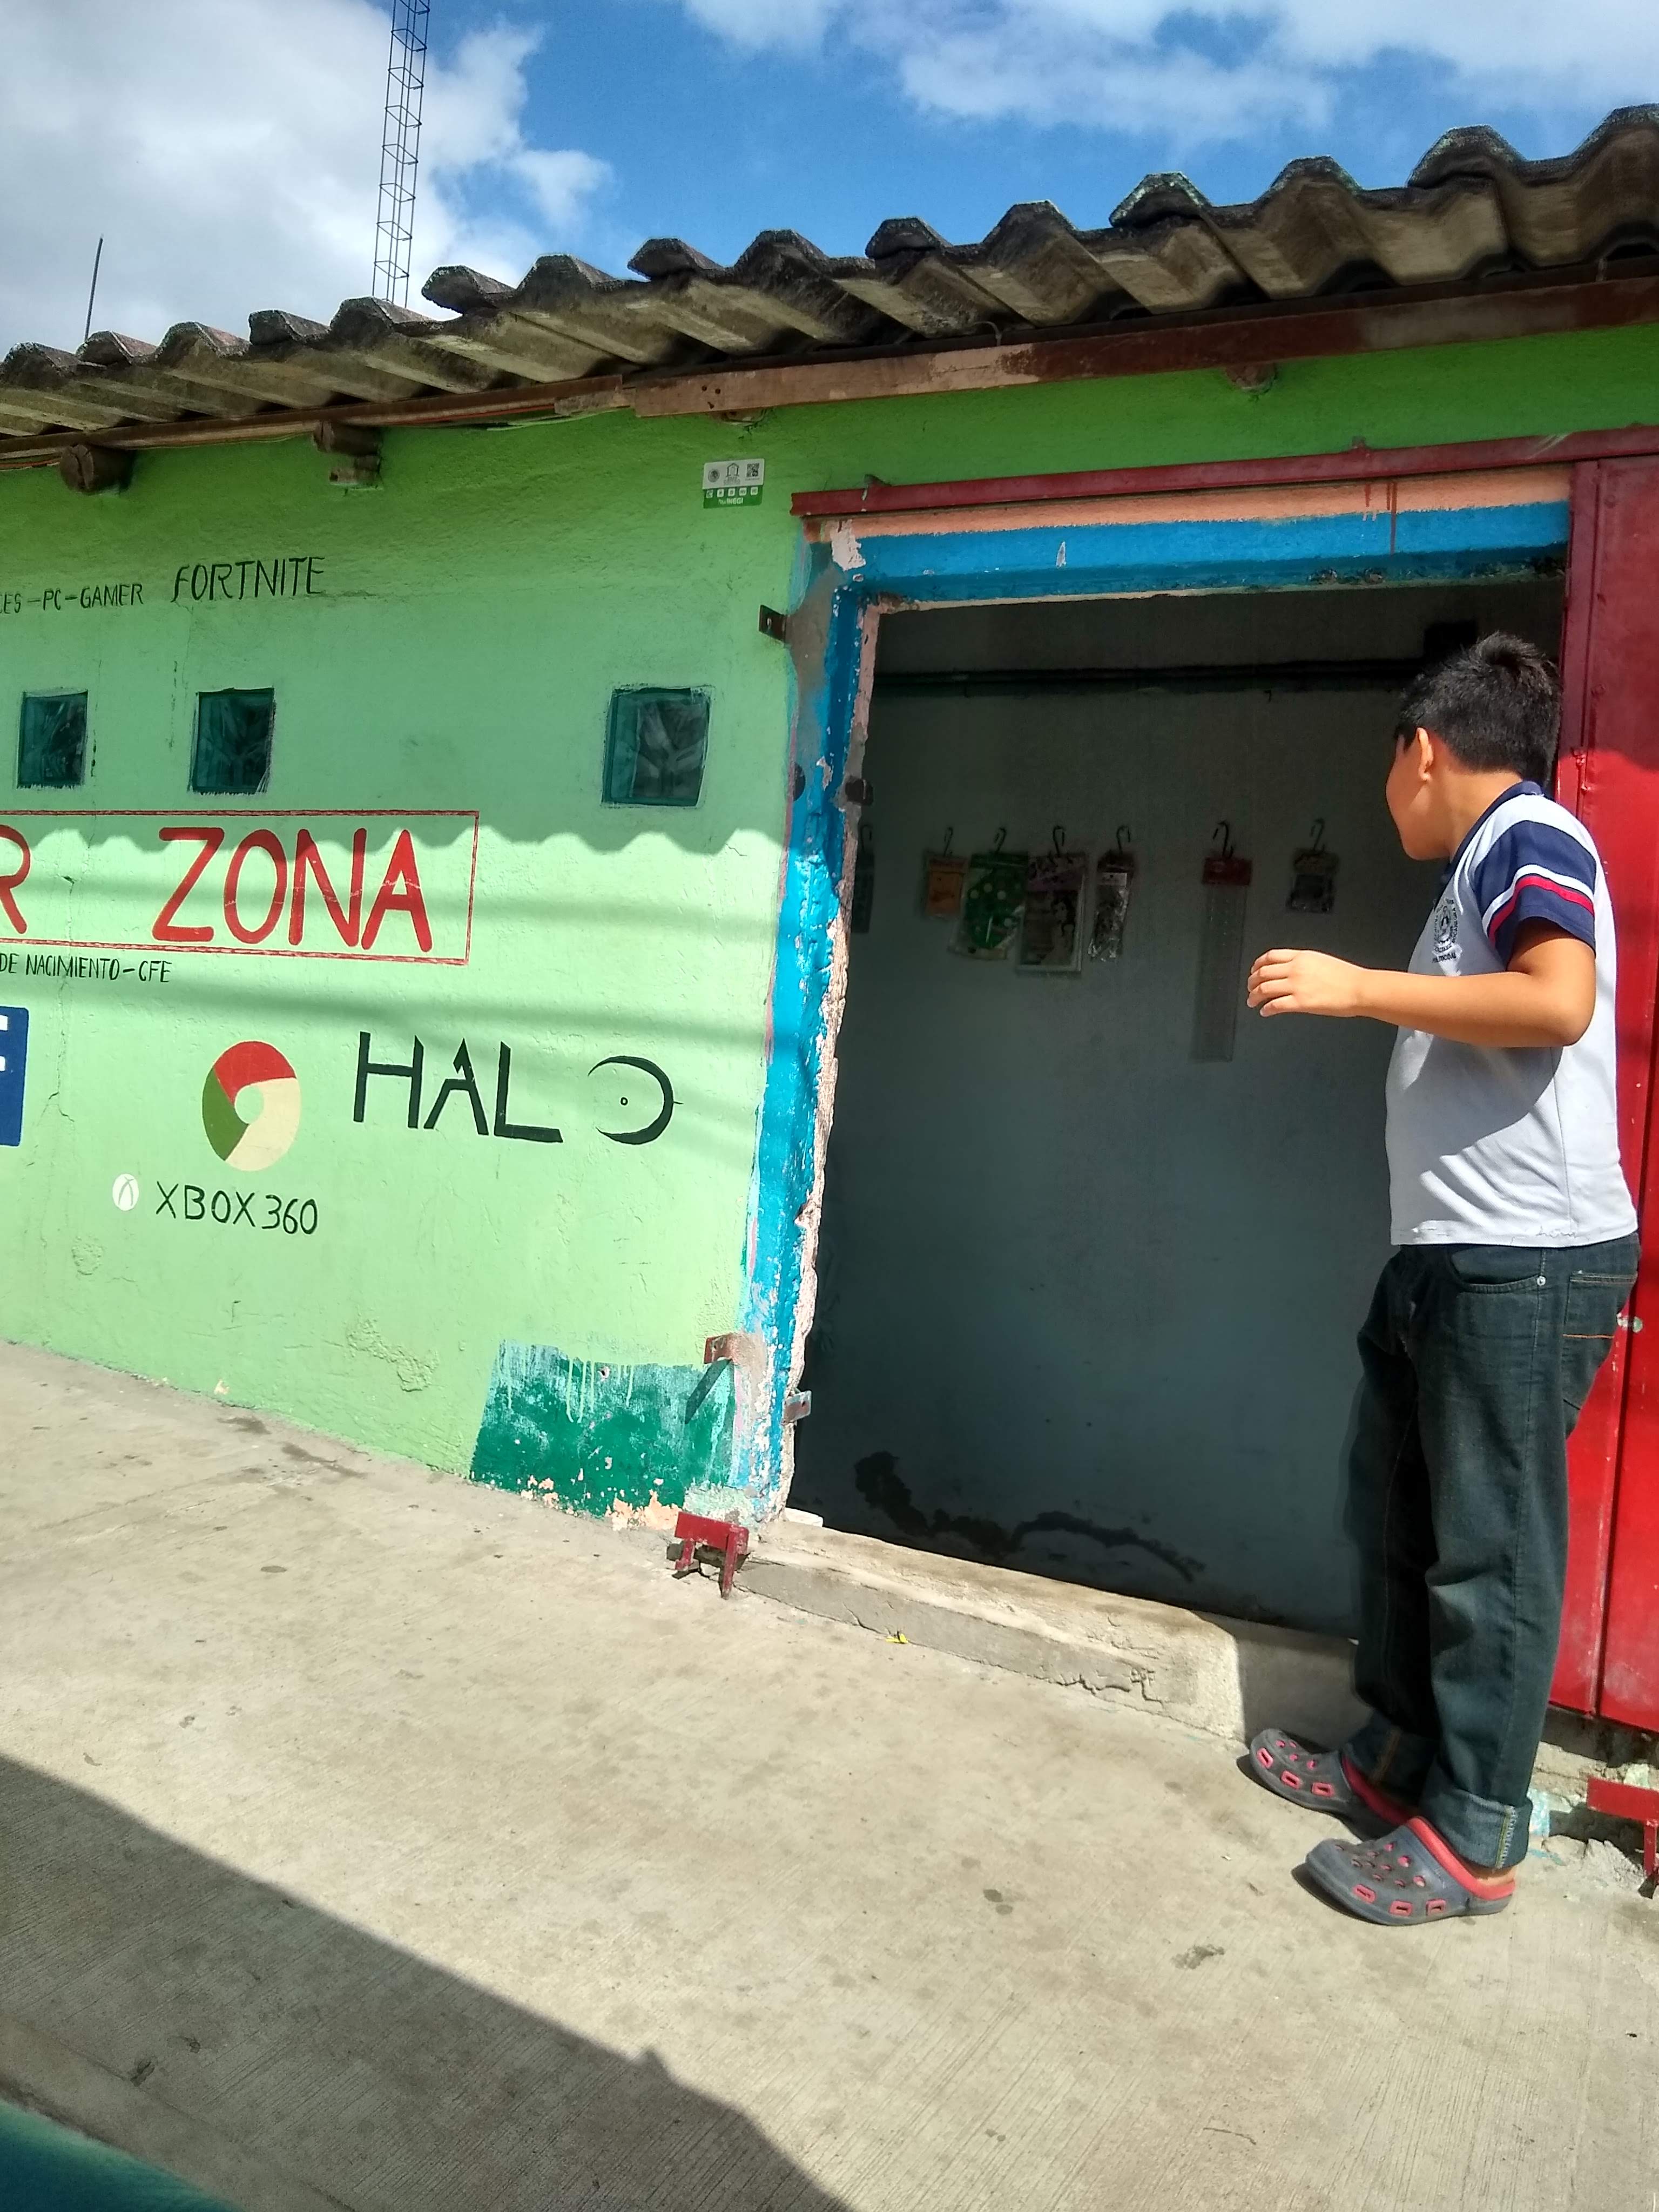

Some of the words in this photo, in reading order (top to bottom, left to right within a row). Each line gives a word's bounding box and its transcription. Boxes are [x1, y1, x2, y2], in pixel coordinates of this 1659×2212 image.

[170, 557, 326, 602] FORTNITE
[152, 827, 433, 952] ZONA
[0, 953, 19, 974] DE
[353, 1031, 684, 1145] HALO
